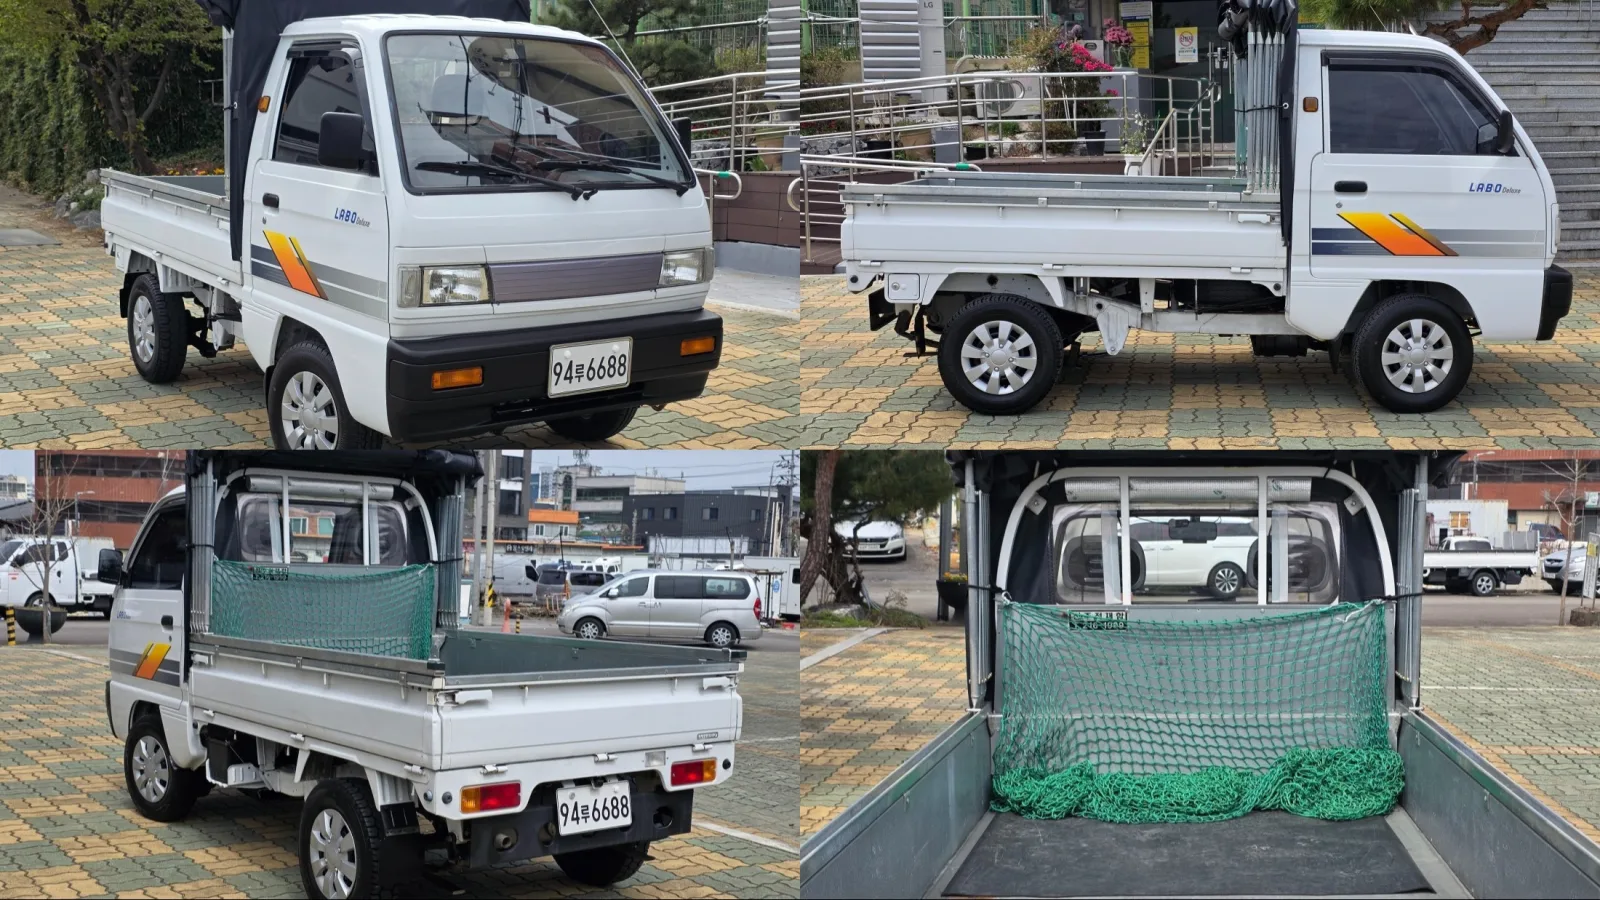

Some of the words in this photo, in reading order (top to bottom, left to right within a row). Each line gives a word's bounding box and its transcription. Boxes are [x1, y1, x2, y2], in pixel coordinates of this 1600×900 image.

[1469, 183, 1502, 193] LABO
[1502, 186, 1521, 194] Deluxe
[334, 207, 357, 224] LABO
[553, 354, 626, 386] 94루6688
[560, 795, 629, 827] 94루6688
